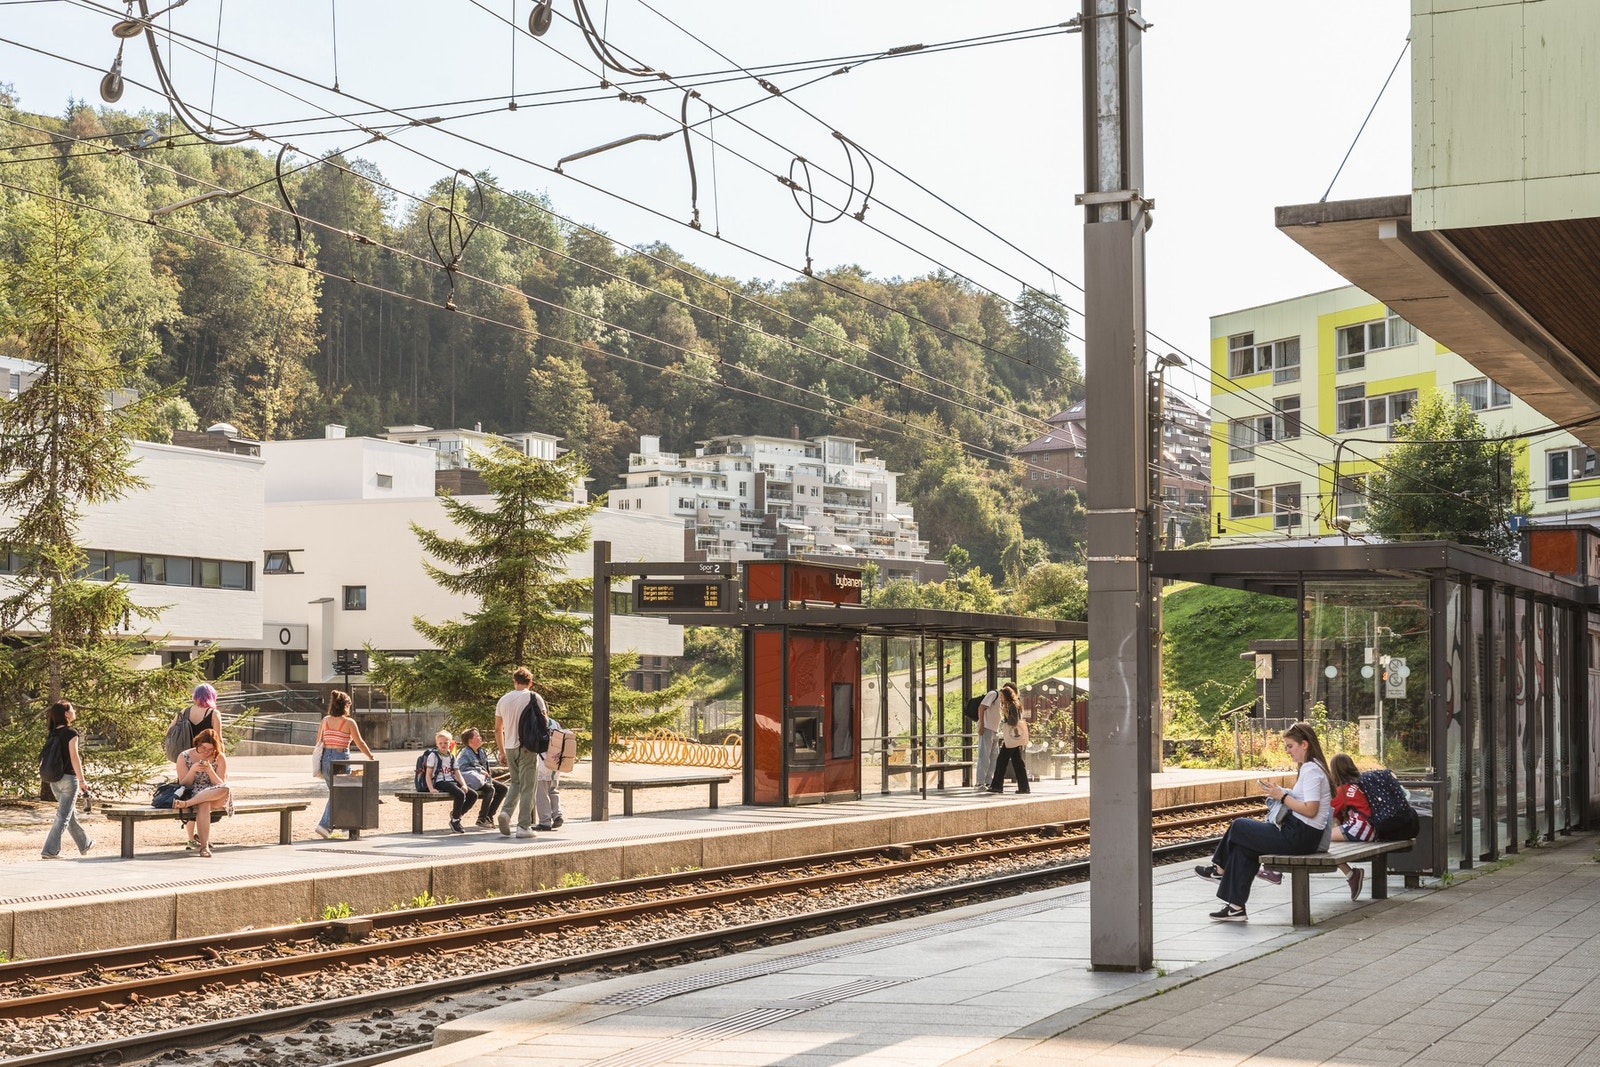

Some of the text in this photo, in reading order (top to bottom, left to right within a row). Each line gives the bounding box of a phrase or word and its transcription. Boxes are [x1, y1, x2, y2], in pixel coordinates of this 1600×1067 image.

[1217, 512, 1226, 534] L
[1514, 516, 1522, 527] T
[699, 563, 713, 572] Spor
[714, 564, 720, 573] 2
[835, 573, 863, 589] bybanen
